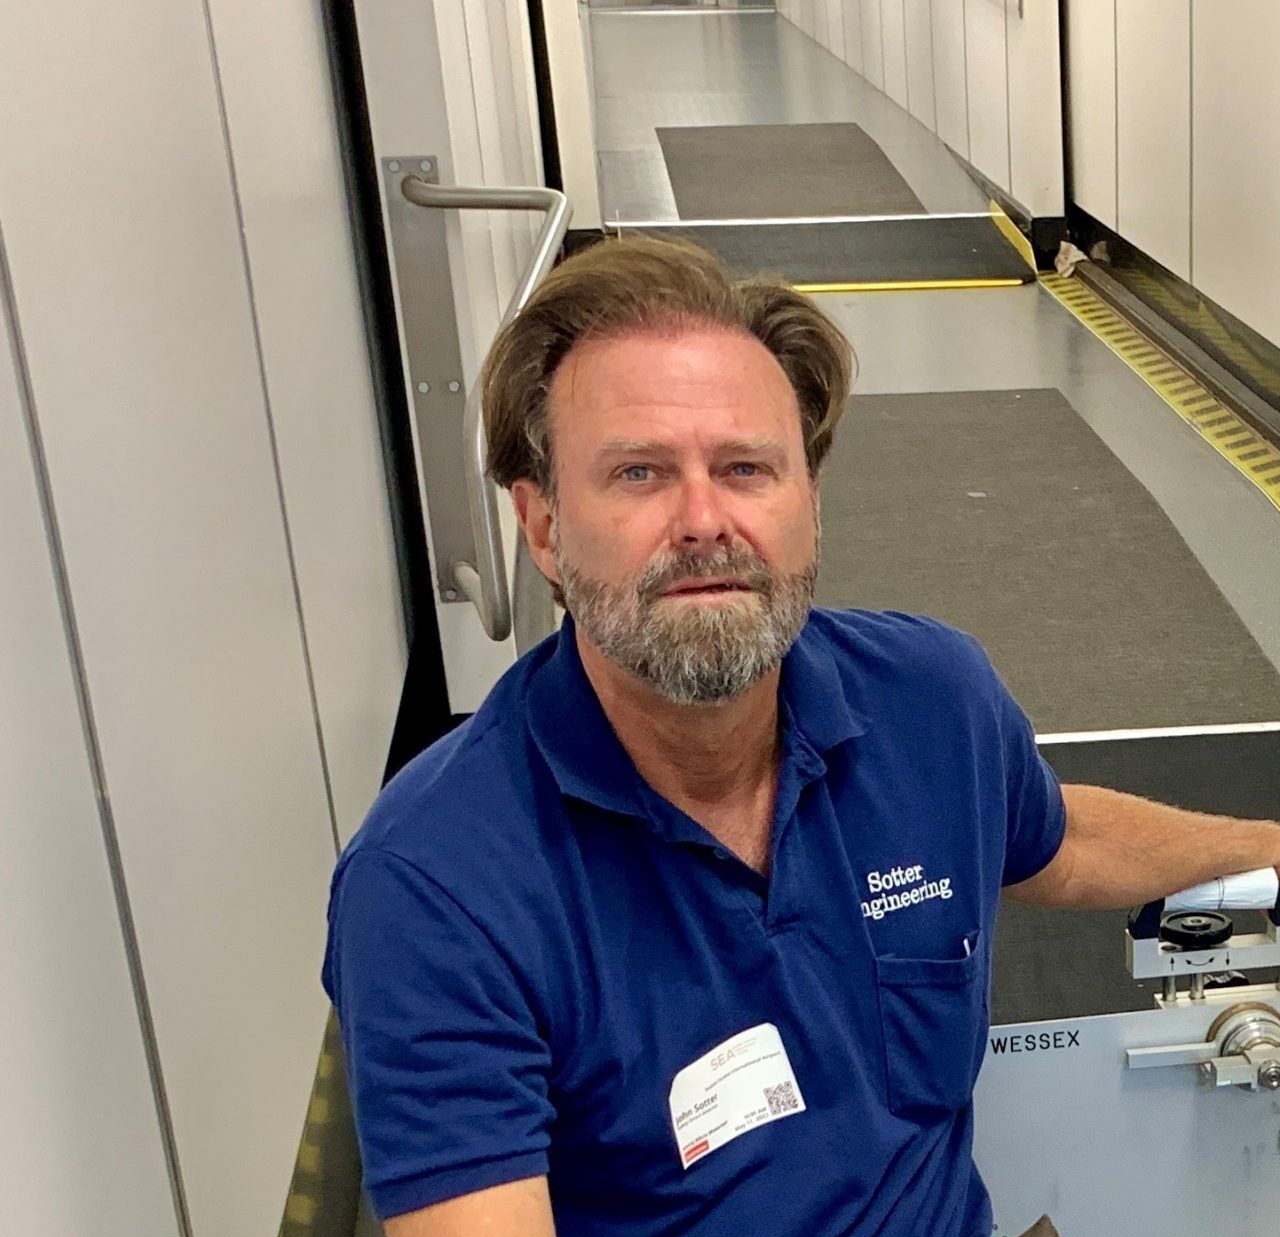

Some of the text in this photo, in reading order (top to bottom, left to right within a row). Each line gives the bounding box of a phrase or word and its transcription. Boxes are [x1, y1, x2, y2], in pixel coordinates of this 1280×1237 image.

[867, 864, 924, 893] Sotter
[860, 877, 953, 920] ngineering
[990, 1029, 1080, 1054] WESSEX
[710, 1048, 736, 1071] SEA
[676, 1109, 693, 1126] John
[694, 1093, 718, 1113] Sotter
